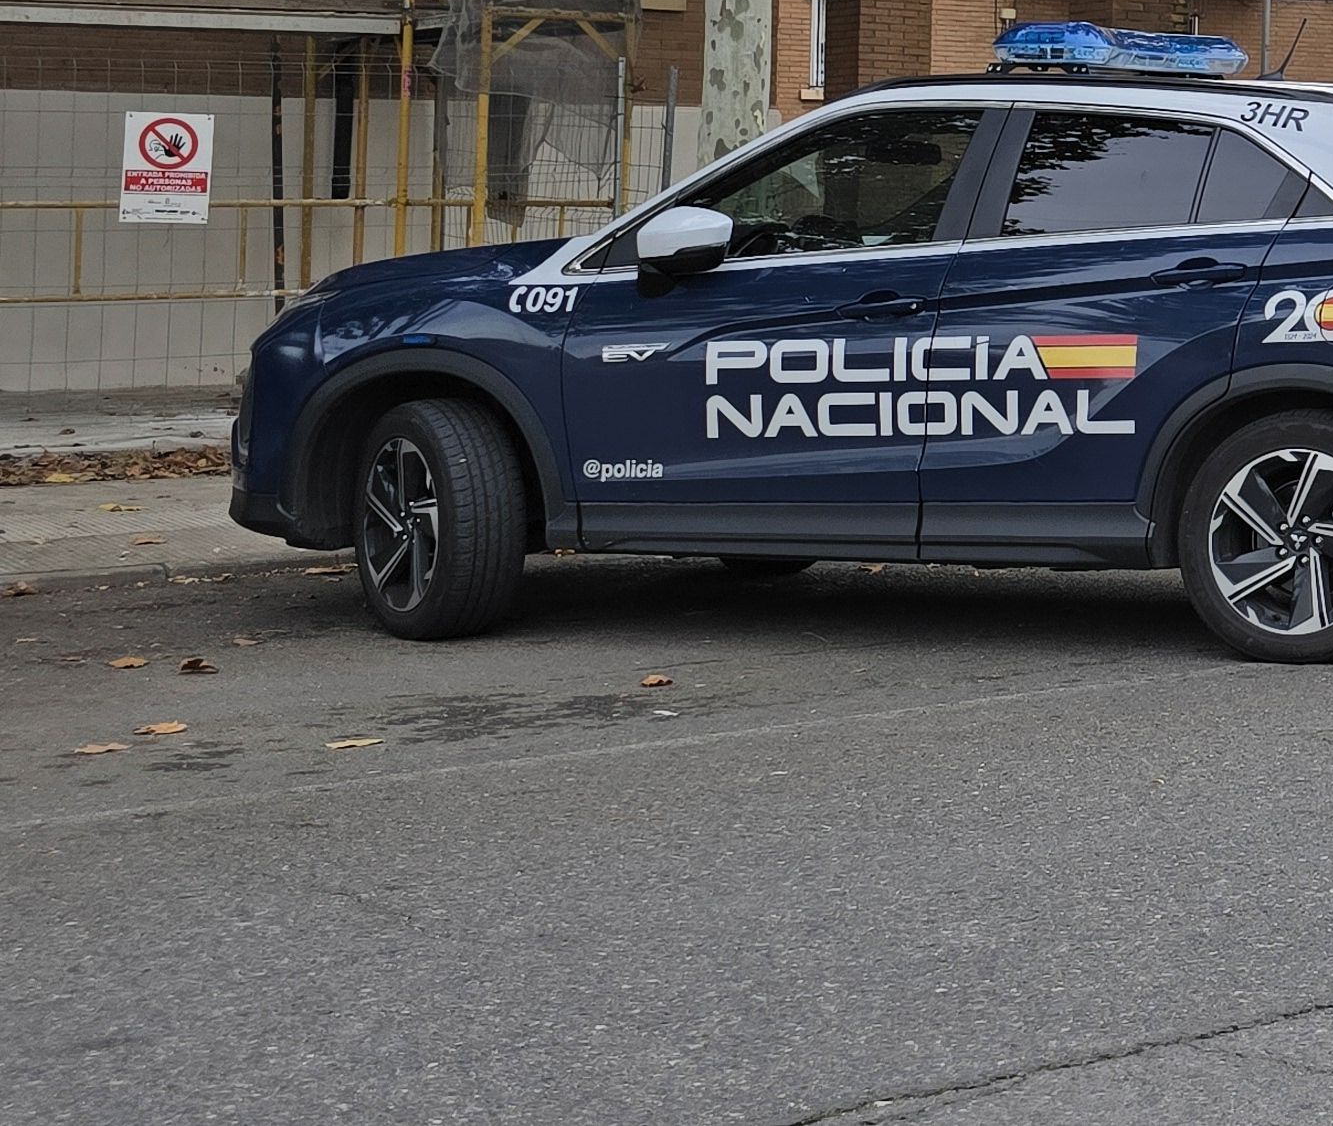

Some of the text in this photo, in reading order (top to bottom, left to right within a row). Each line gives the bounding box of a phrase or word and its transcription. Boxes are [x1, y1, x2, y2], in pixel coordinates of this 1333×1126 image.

[1240, 101, 1310, 132] 3HR
[126, 170, 163, 178] ENTRADA
[148, 178, 192, 186] PERSONAS
[602, 349, 657, 363] EV
[706, 389, 1136, 440] NACIONAL
[582, 459, 664, 483] @policia
